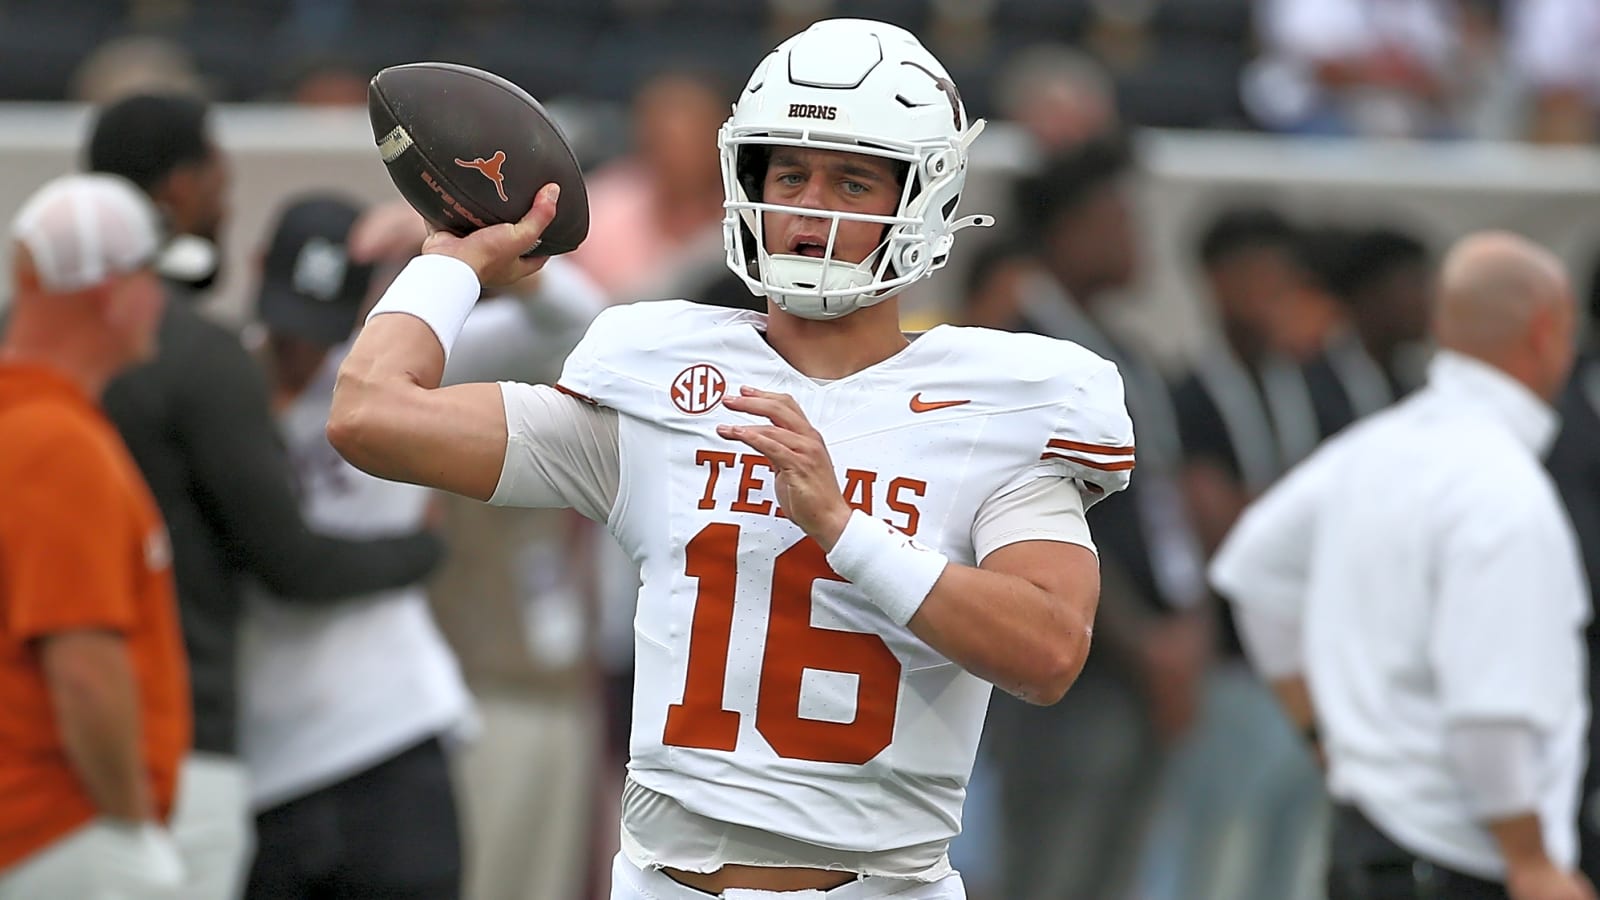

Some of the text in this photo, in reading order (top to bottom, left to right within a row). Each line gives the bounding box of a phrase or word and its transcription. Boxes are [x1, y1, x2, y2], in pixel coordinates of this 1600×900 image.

[788, 104, 837, 120] HORNS
[673, 366, 724, 412] SEC
[696, 450, 927, 537] TEAS
[662, 522, 902, 765] 16
